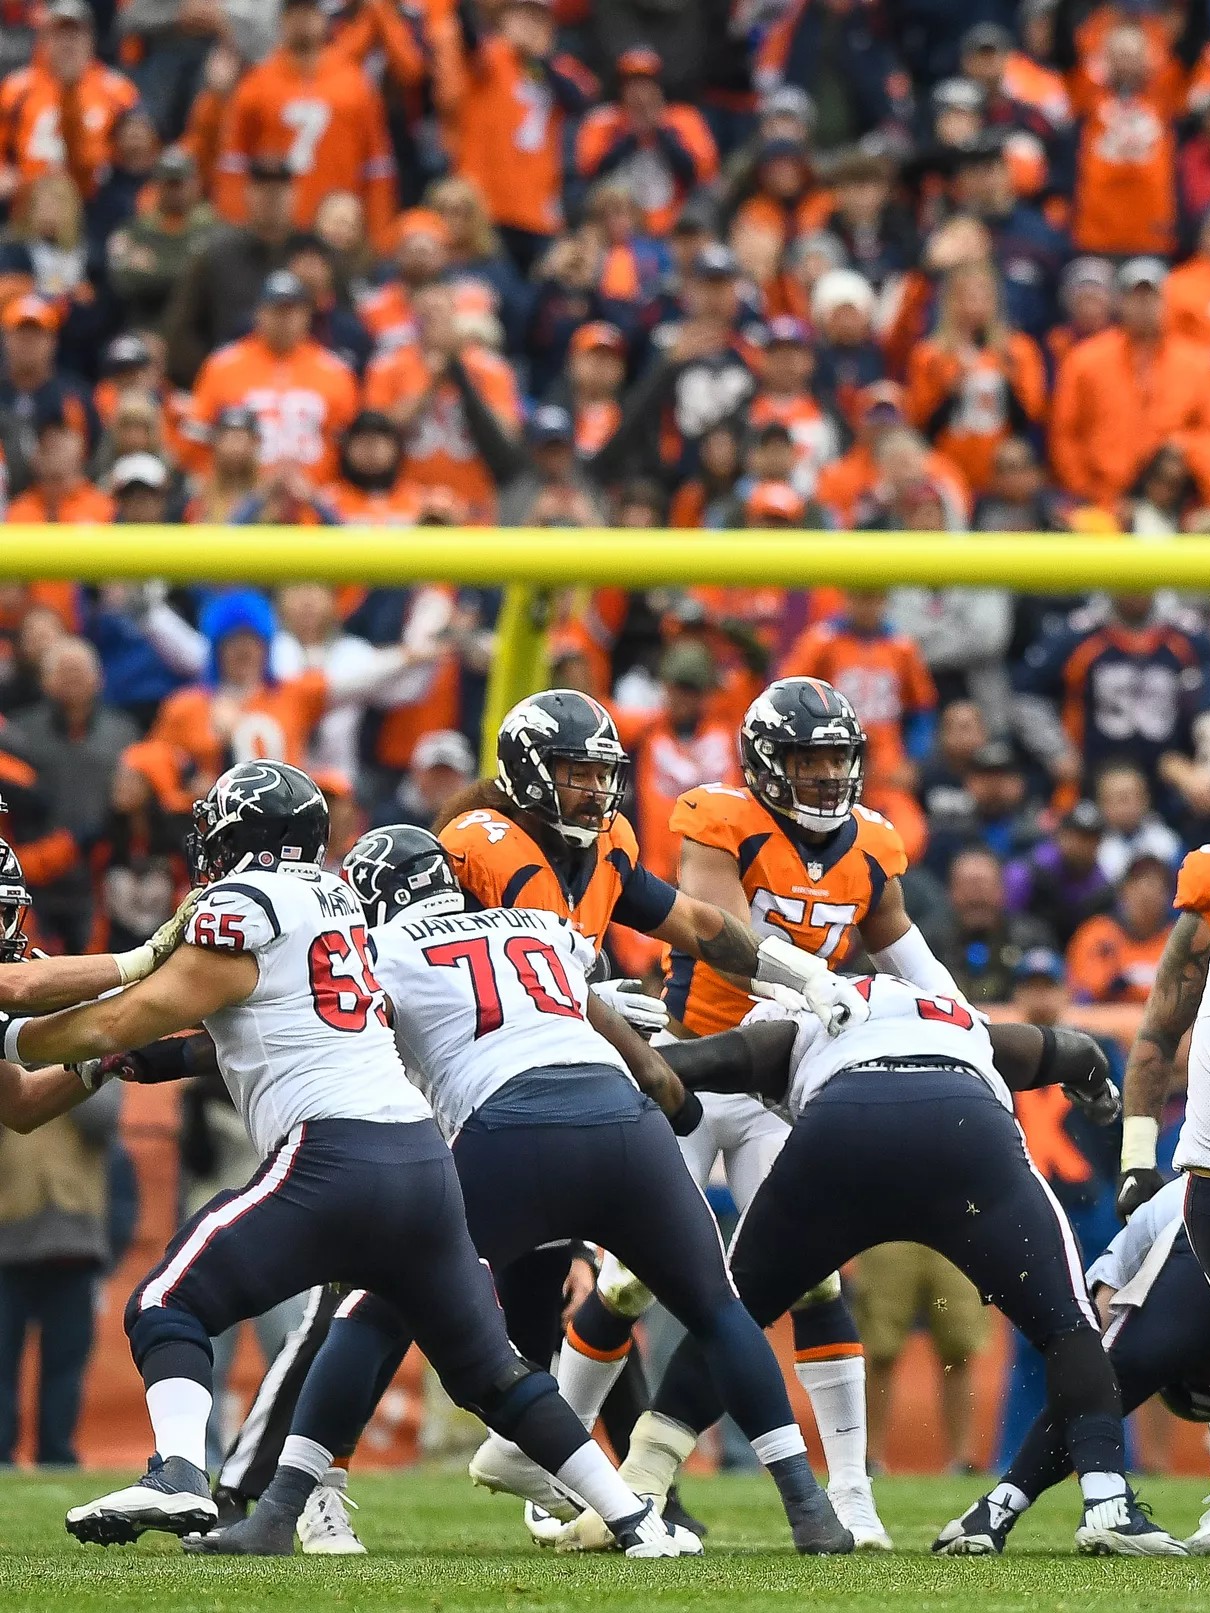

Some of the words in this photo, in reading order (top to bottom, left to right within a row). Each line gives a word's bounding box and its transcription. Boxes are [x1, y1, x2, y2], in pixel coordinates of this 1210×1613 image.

[282, 99, 333, 174] 7
[195, 913, 247, 951] 65
[421, 935, 585, 1042] 70
[1085, 1497, 1131, 1529] NIKE
